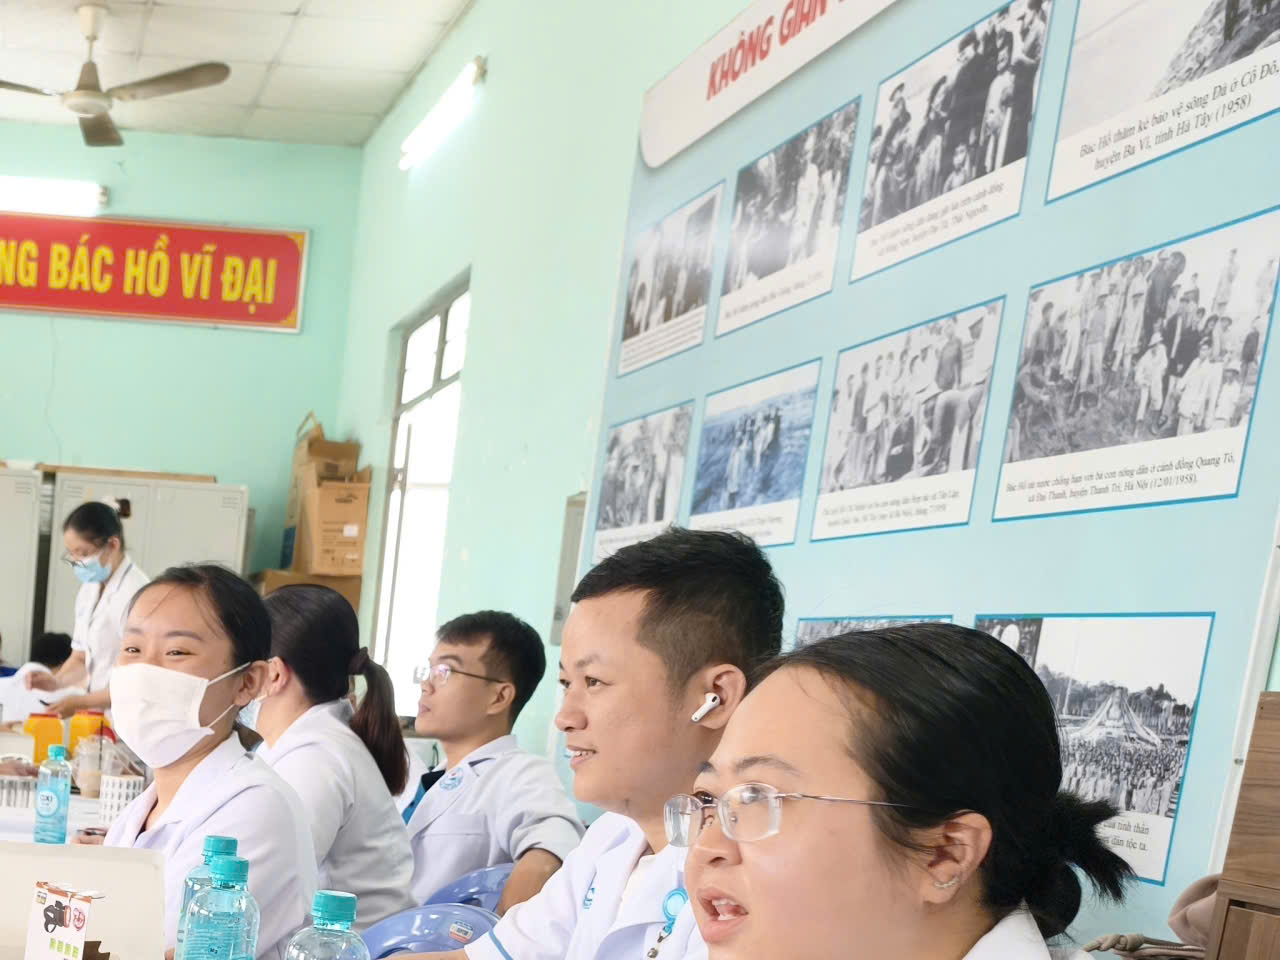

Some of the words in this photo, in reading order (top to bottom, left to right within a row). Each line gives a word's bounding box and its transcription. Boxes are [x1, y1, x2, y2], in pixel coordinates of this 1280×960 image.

[706, 16, 775, 101] KHÔNG
[1216, 92, 1252, 122] (1958)
[48, 234, 114, 293] BÁC
[123, 233, 170, 298] HỒ
[180, 243, 217, 300] VĨ
[220, 255, 278, 315] ĐẠI
